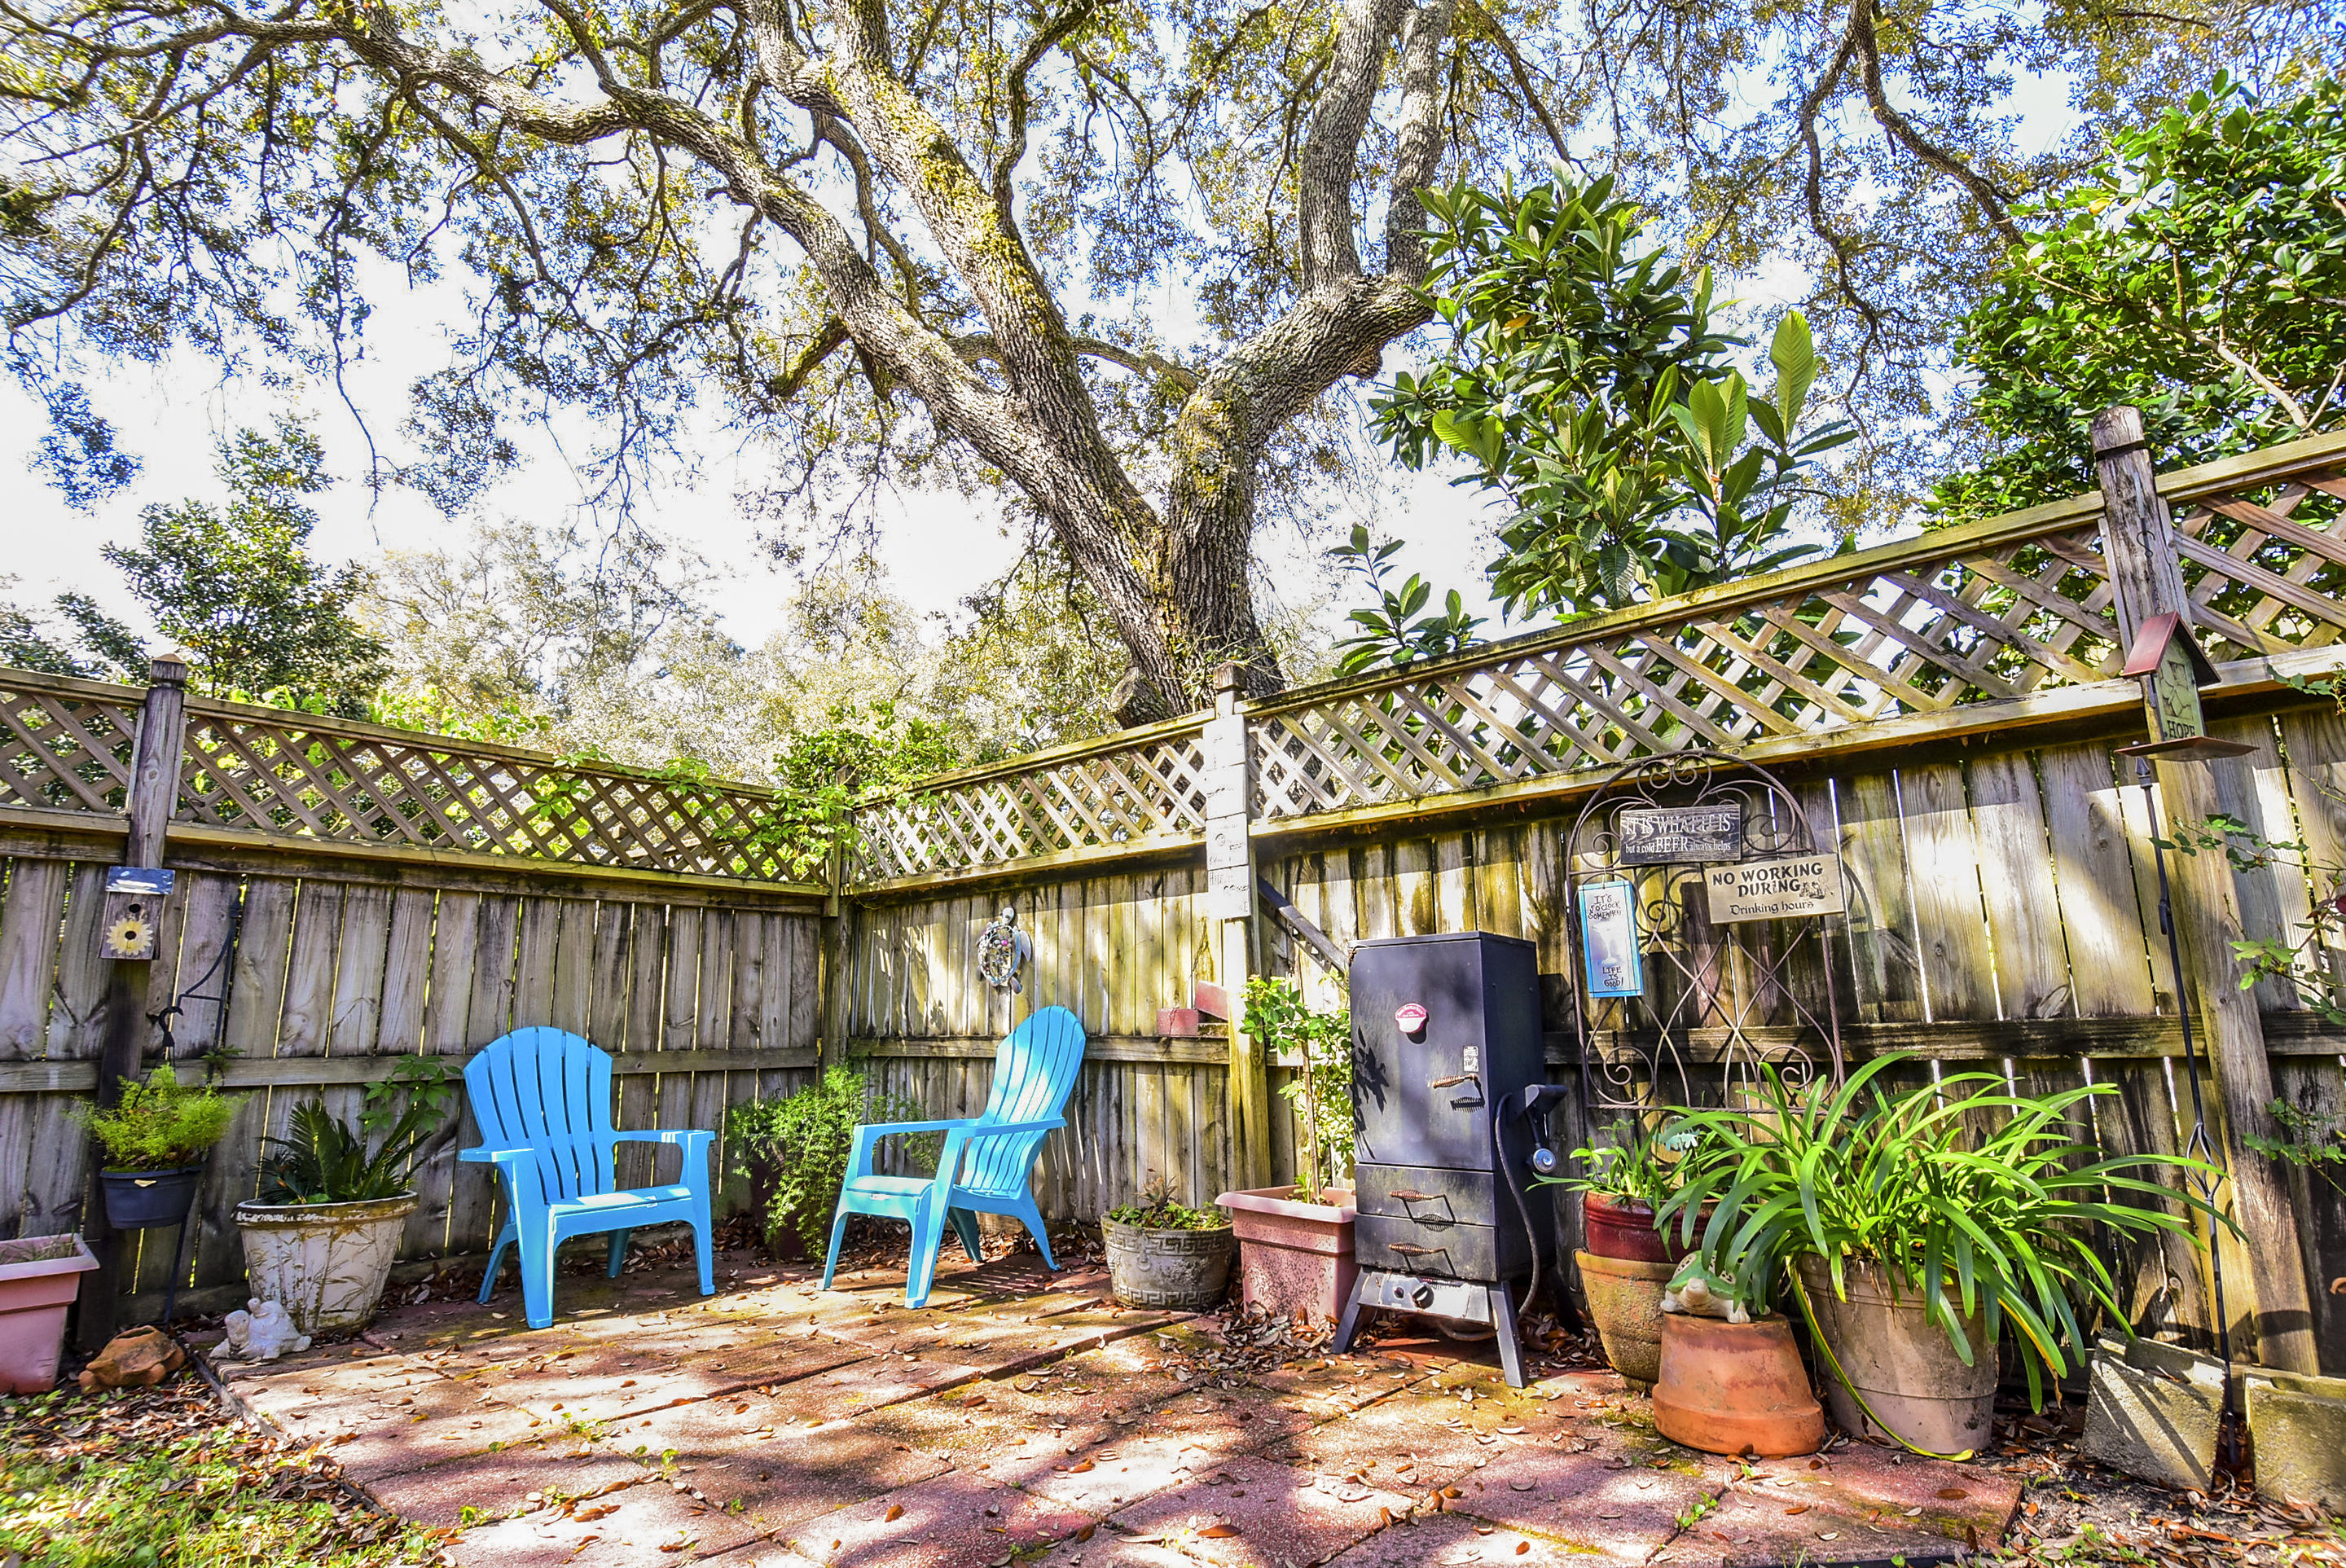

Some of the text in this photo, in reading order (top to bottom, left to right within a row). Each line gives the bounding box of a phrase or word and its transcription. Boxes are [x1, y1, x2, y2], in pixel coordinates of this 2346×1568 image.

[2167, 720, 2196, 739] HOPE
[1626, 816, 1638, 835] IT
[1641, 815, 1654, 834] IS
[1658, 815, 1698, 833] WHAT
[1718, 814, 1731, 832] IS
[1625, 837, 1731, 854] but a cold BEER always helps
[1712, 862, 1824, 885] NO WORKING
[1738, 879, 1801, 897] DURING
[1594, 894, 1612, 904] IT'S
[1729, 901, 1814, 915] Drinking hours
[1602, 966, 1622, 974] LIFE
[1604, 977, 1623, 987] GOOD!
